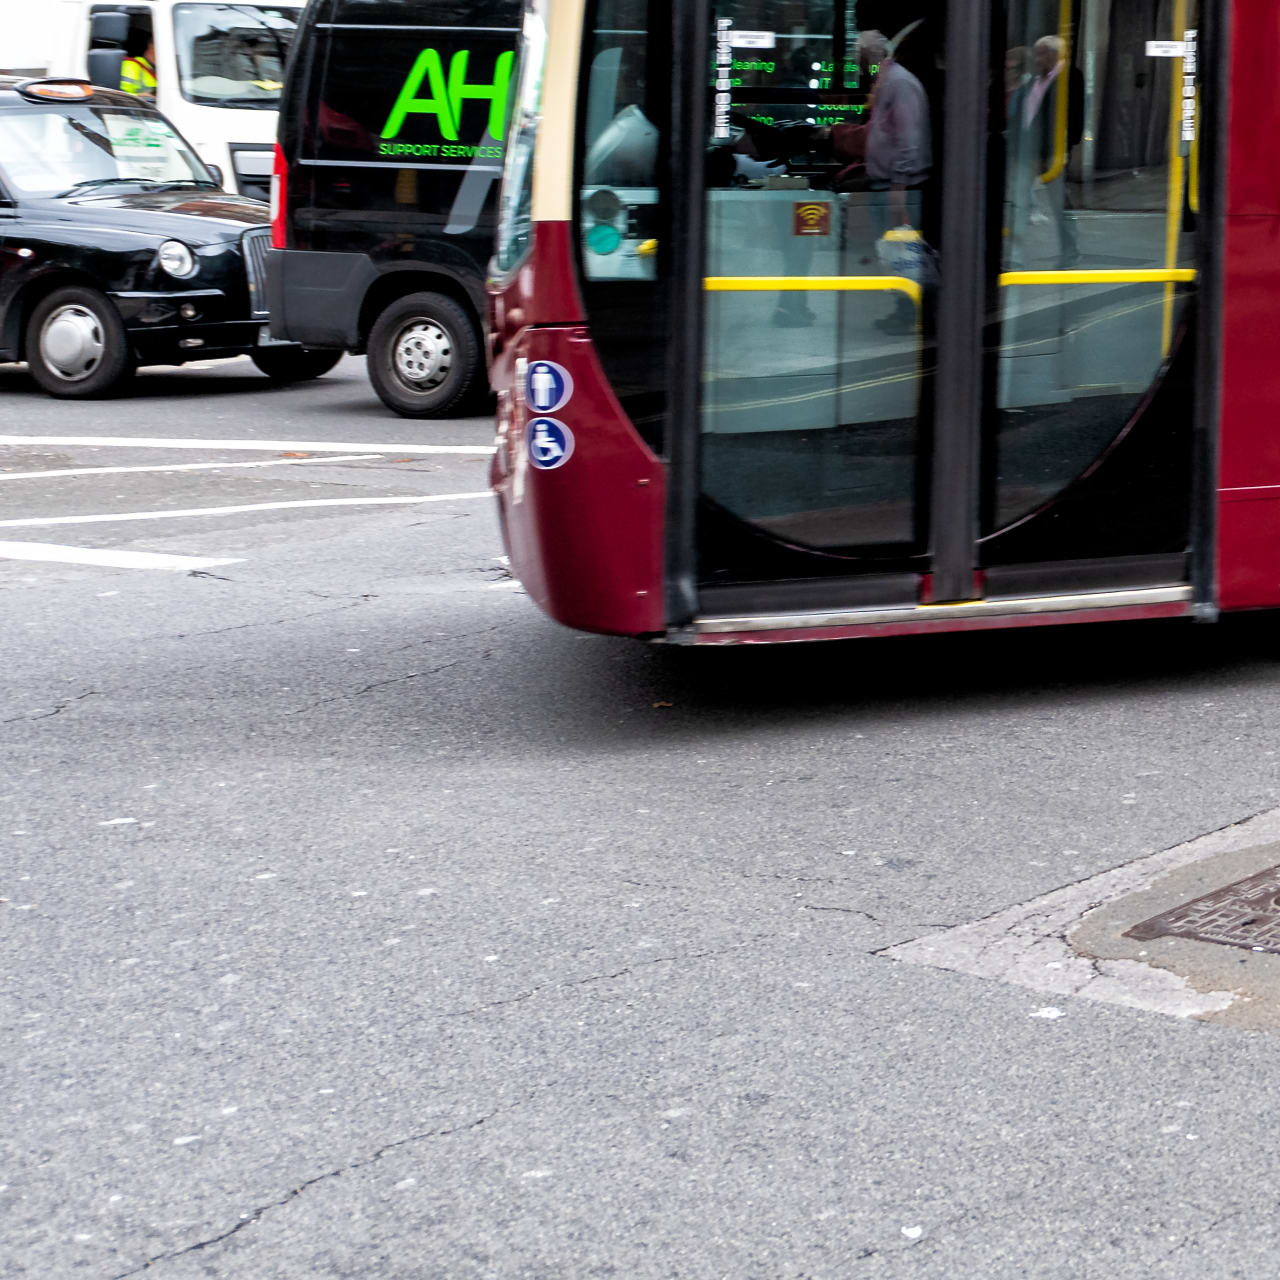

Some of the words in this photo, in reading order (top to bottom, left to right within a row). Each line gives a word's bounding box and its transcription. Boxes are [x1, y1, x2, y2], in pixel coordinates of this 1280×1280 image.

[379, 47, 515, 142] AH
[379, 143, 440, 157] SUPPORT
[440, 145, 503, 159] SERVICES
